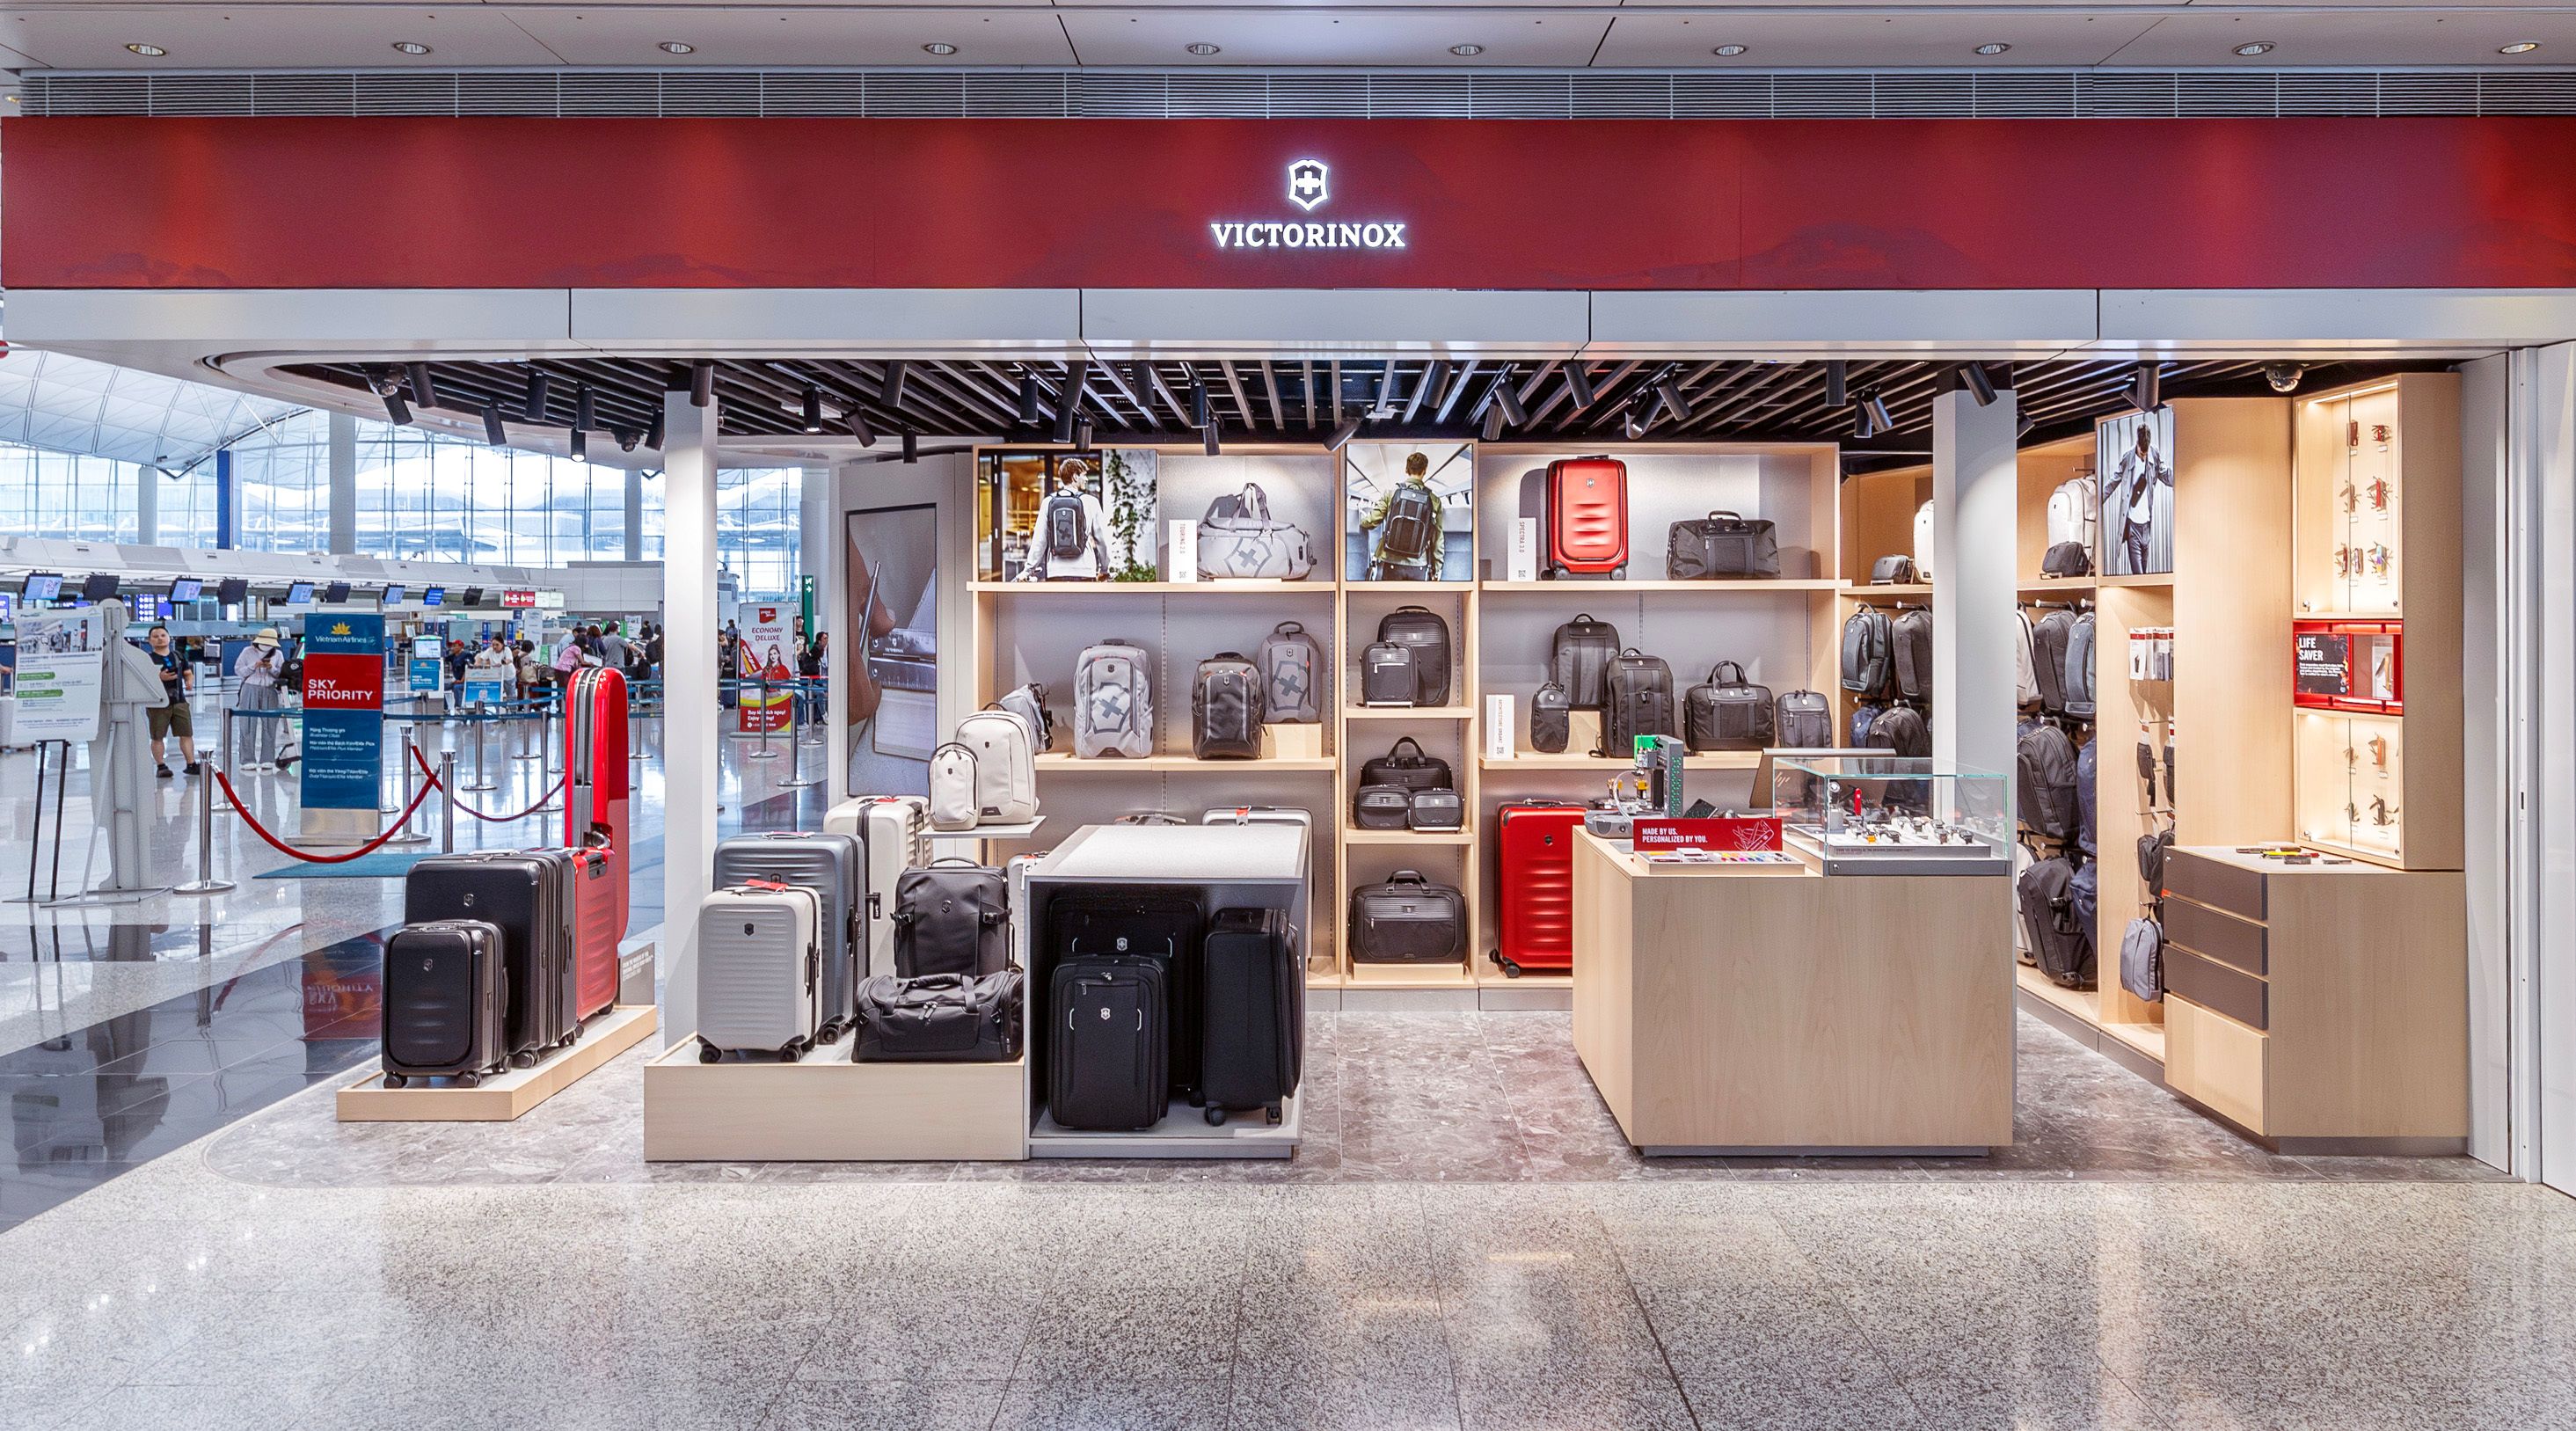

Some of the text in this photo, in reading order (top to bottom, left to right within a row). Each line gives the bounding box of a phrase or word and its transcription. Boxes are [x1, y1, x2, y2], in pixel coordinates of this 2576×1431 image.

[1210, 223, 1405, 247] VICTORINOX
[2298, 637, 2317, 649] LIFE
[2298, 649, 2324, 661] SAVER
[309, 679, 336, 690] SKY
[308, 690, 373, 700] PRIORITY
